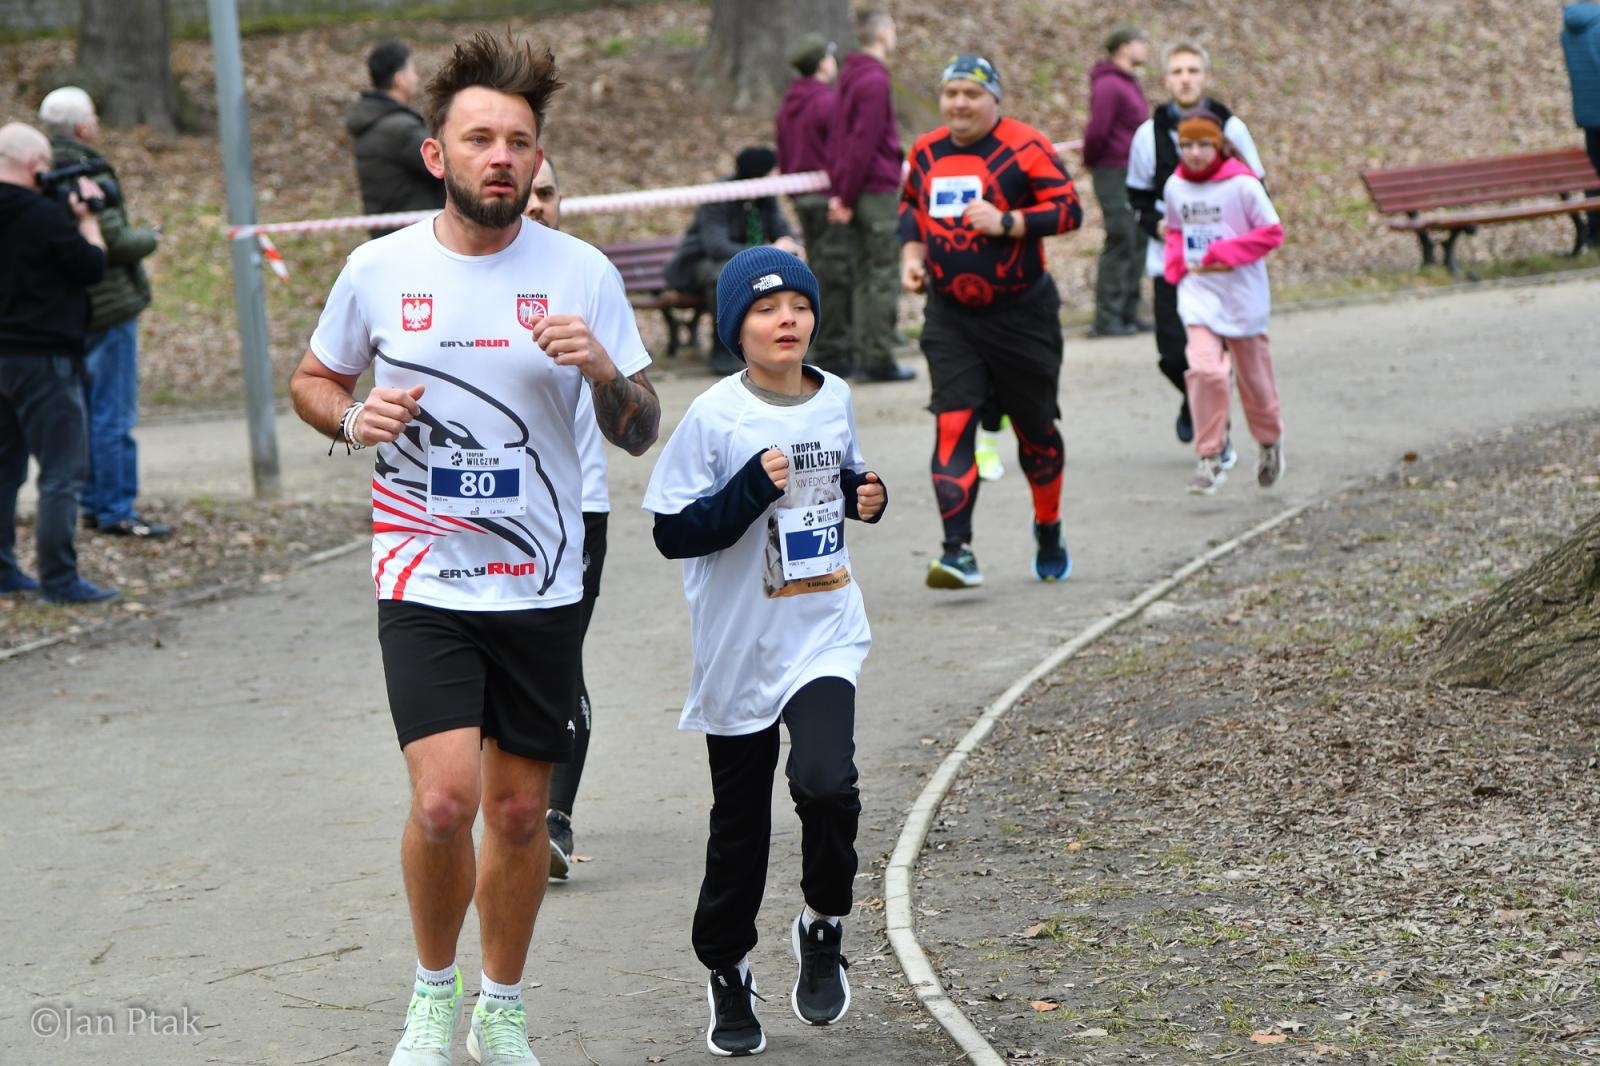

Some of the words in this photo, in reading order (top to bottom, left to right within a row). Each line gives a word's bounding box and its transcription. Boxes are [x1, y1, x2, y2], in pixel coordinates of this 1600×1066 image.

[791, 441, 821, 454] TROPEM
[466, 457, 500, 466] WILCZYM
[460, 471, 496, 497] 80
[812, 526, 838, 555] 79
